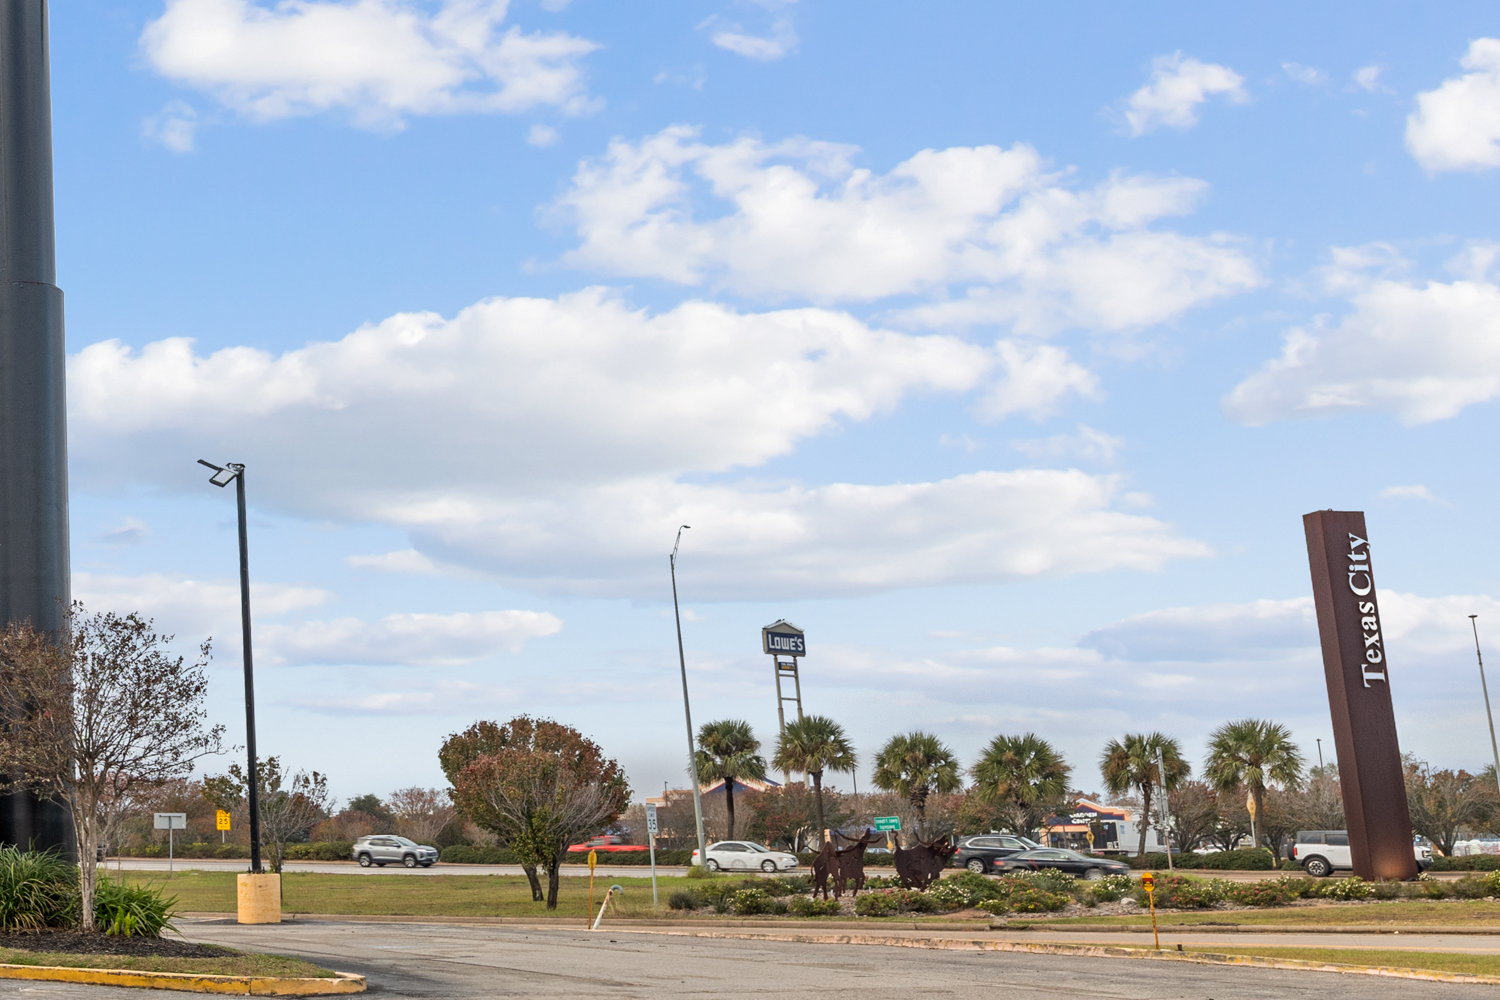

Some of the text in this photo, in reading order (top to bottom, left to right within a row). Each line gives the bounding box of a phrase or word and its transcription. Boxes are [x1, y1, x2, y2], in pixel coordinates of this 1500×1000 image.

[1347, 532, 1387, 688] Texas City
[768, 633, 804, 651] LOWE'S
[218, 817, 229, 825] 25
